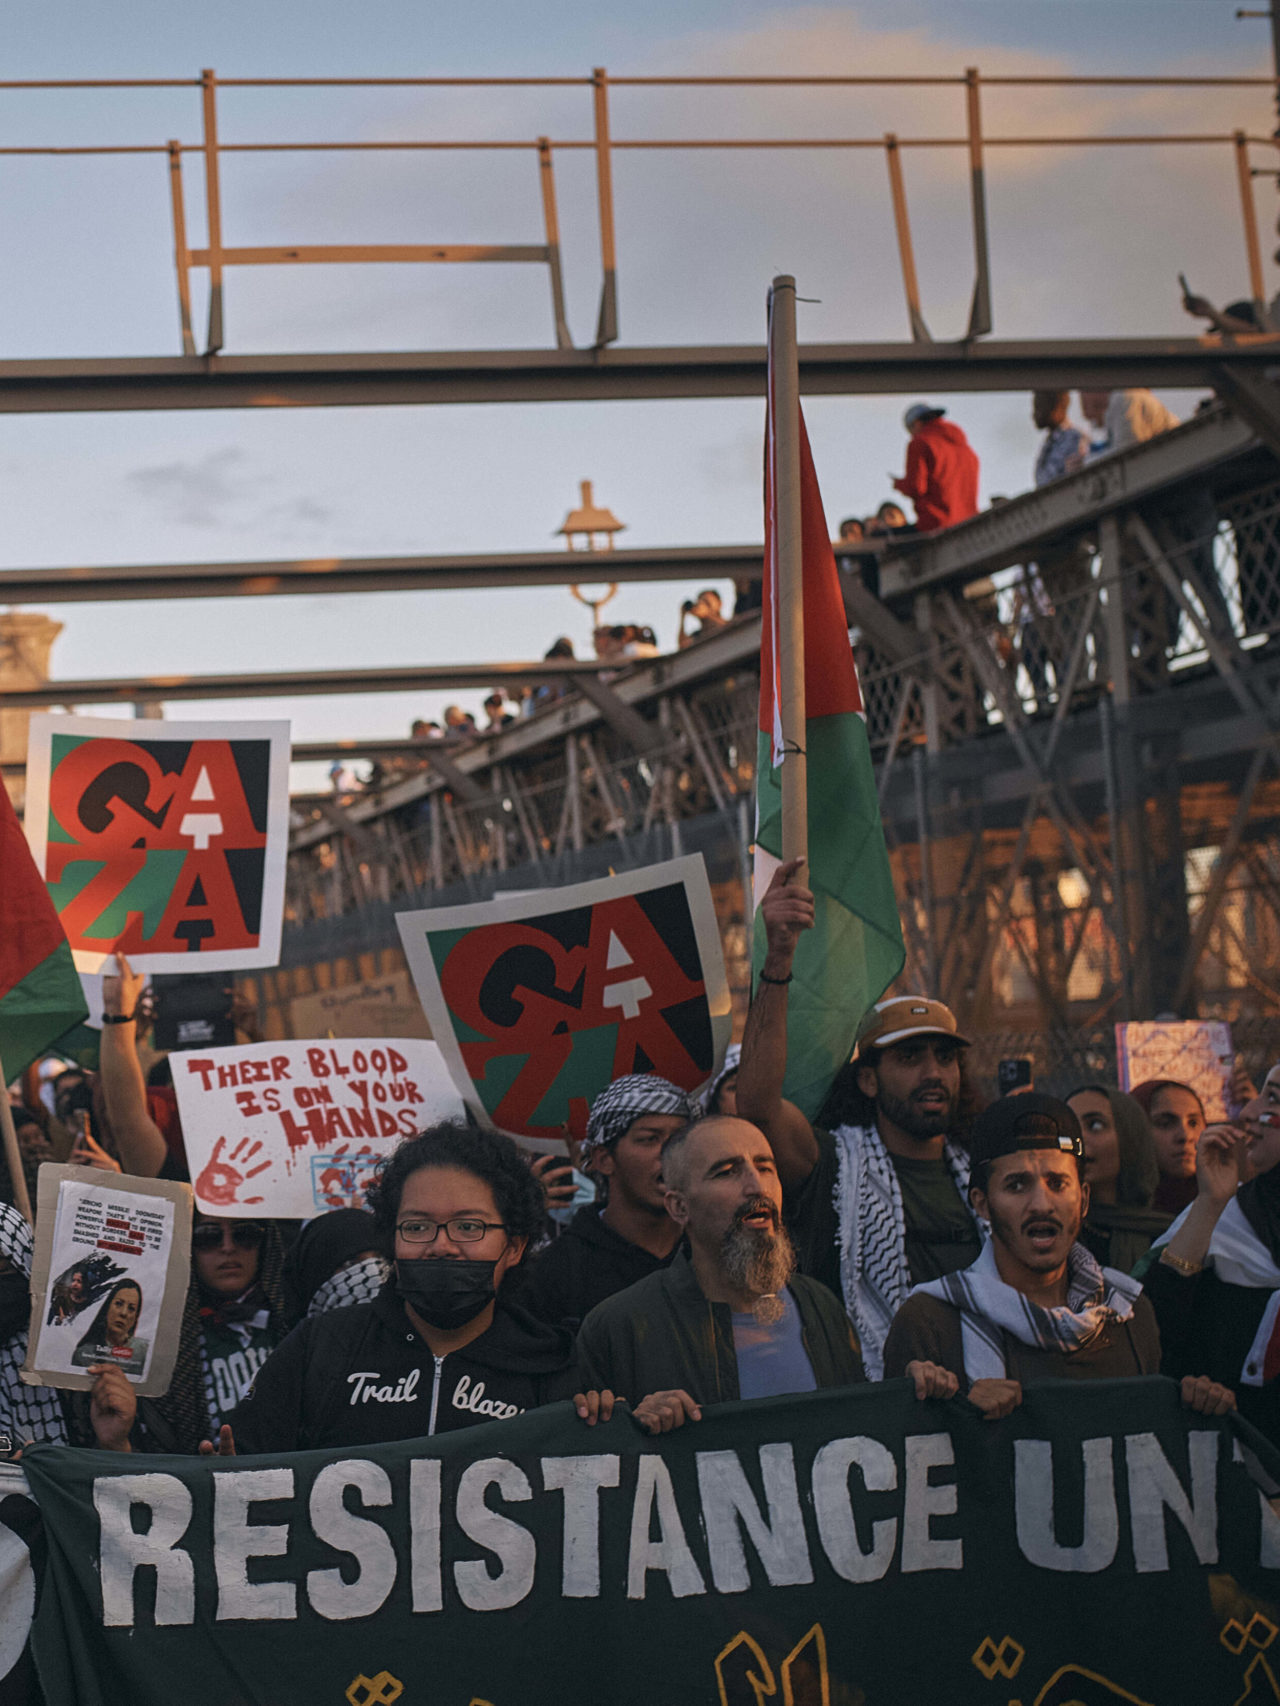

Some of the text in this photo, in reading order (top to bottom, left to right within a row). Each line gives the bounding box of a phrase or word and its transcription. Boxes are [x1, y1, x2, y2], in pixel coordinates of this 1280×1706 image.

[187, 1047, 408, 1091] THEIR BLOOD
[235, 1078, 425, 1117] IS ON YOUR
[278, 1107, 419, 1147] HANDS
[347, 1368, 525, 1420] Trail blaze
[93, 1432, 963, 1627] RESISTANCE
